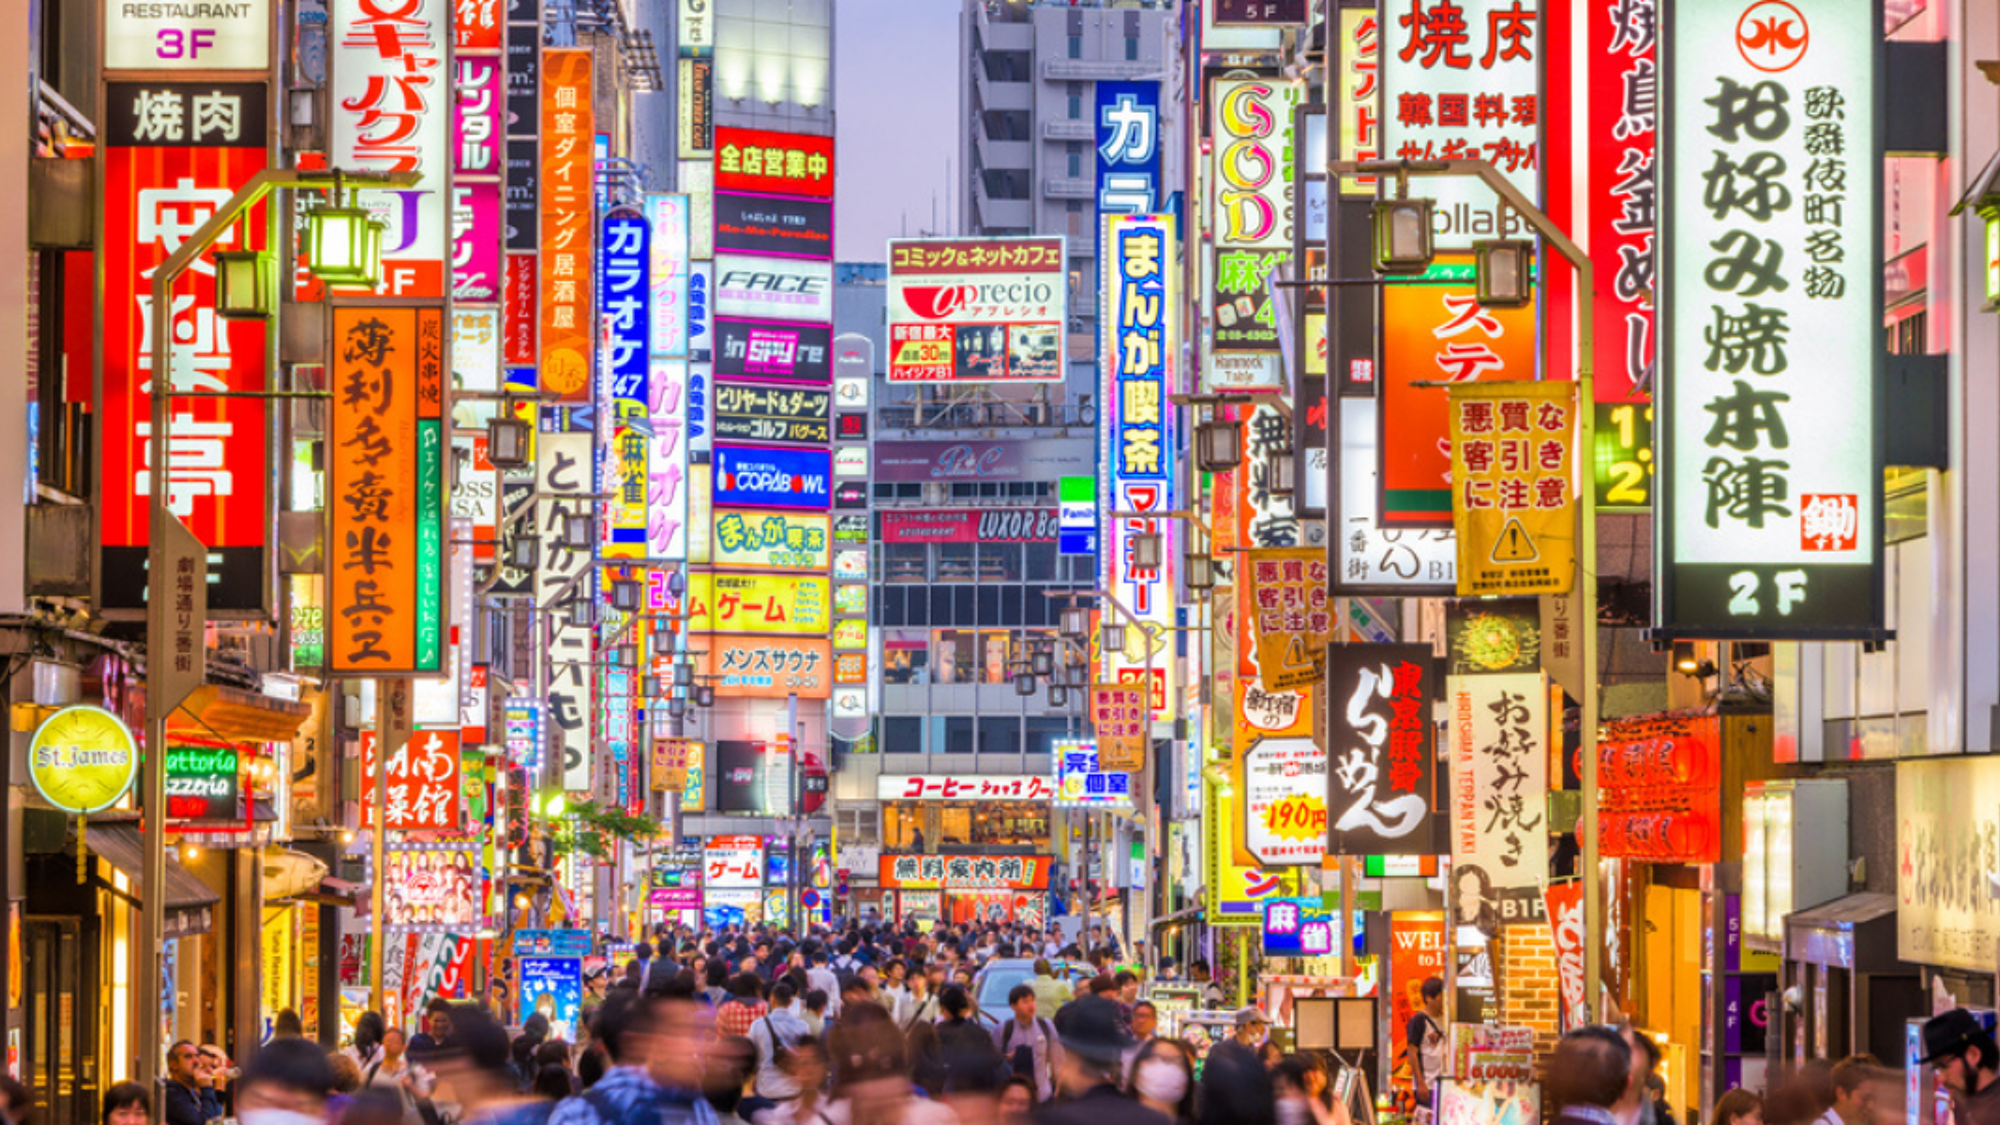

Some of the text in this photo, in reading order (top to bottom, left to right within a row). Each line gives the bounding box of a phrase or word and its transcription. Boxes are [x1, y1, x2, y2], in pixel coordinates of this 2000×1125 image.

[122, 2, 251, 19] RESTAURANT
[156, 29, 216, 60] 3F
[1399, 0, 1537, 69] 焼肉
[132, 90, 242, 142] 焼肉
[461, 60, 493, 170] レンタル
[1397, 92, 1537, 128] 韓国料理
[719, 143, 829, 181] 全店営業中
[1100, 94, 1156, 215] カラ
[1219, 82, 1275, 243] GOD
[552, 86, 578, 329] 個室ダイニング居酒屋
[1802, 85, 1846, 300] 歌舞伎町名物
[893, 245, 1060, 268] コミック&ネットカフェ
[719, 270, 829, 295] FACE
[932, 276, 1052, 317] aprecio
[1702, 75, 1793, 530] お好み焼本陣
[894, 325, 953, 341] 新宿最大
[1123, 232, 1160, 475] まんが喫茶
[1225, 371, 1255, 384] Table
[716, 387, 829, 417] ビリヤード&ダーツ
[1461, 401, 1566, 433] 悪質な
[750, 419, 788, 439] ゴルフ
[623, 433, 645, 504] 麻雀
[649, 370, 684, 554] カラオケ
[1462, 440, 1565, 473] 客引き
[1463, 478, 1567, 511] に注意
[716, 512, 826, 553] まんが喫茶
[977, 510, 1035, 540] LUXOR
[1348, 515, 1370, 582] 一番街
[1256, 560, 1327, 583] 悪質な
[717, 591, 786, 622] ゲーム
[1257, 586, 1328, 609] 客引き
[1728, 569, 1809, 616] 2F
[174, 556, 195, 673] 劇場通り一番街
[1259, 611, 1329, 633] に注意
[721, 649, 821, 672] メンズサウナ
[1097, 690, 1140, 705] 悪質な
[1097, 706, 1140, 721] 客引き
[1098, 722, 1141, 737] に注意
[35, 746, 129, 770] St.James
[1456, 691, 1477, 855] HIROSHIMA TEPPANYAKI
[1085, 773, 1128, 793] 個室
[1481, 689, 1543, 868] お好み焼き
[385, 783, 455, 826] 菜館
[1267, 800, 1328, 829] 190円
[709, 862, 760, 880] ゲーム
[894, 856, 1025, 880] 無料案内所
[1501, 897, 1546, 919] B1F
[270, 928, 282, 953] Tuna
[1267, 902, 1332, 952] 麻雀
